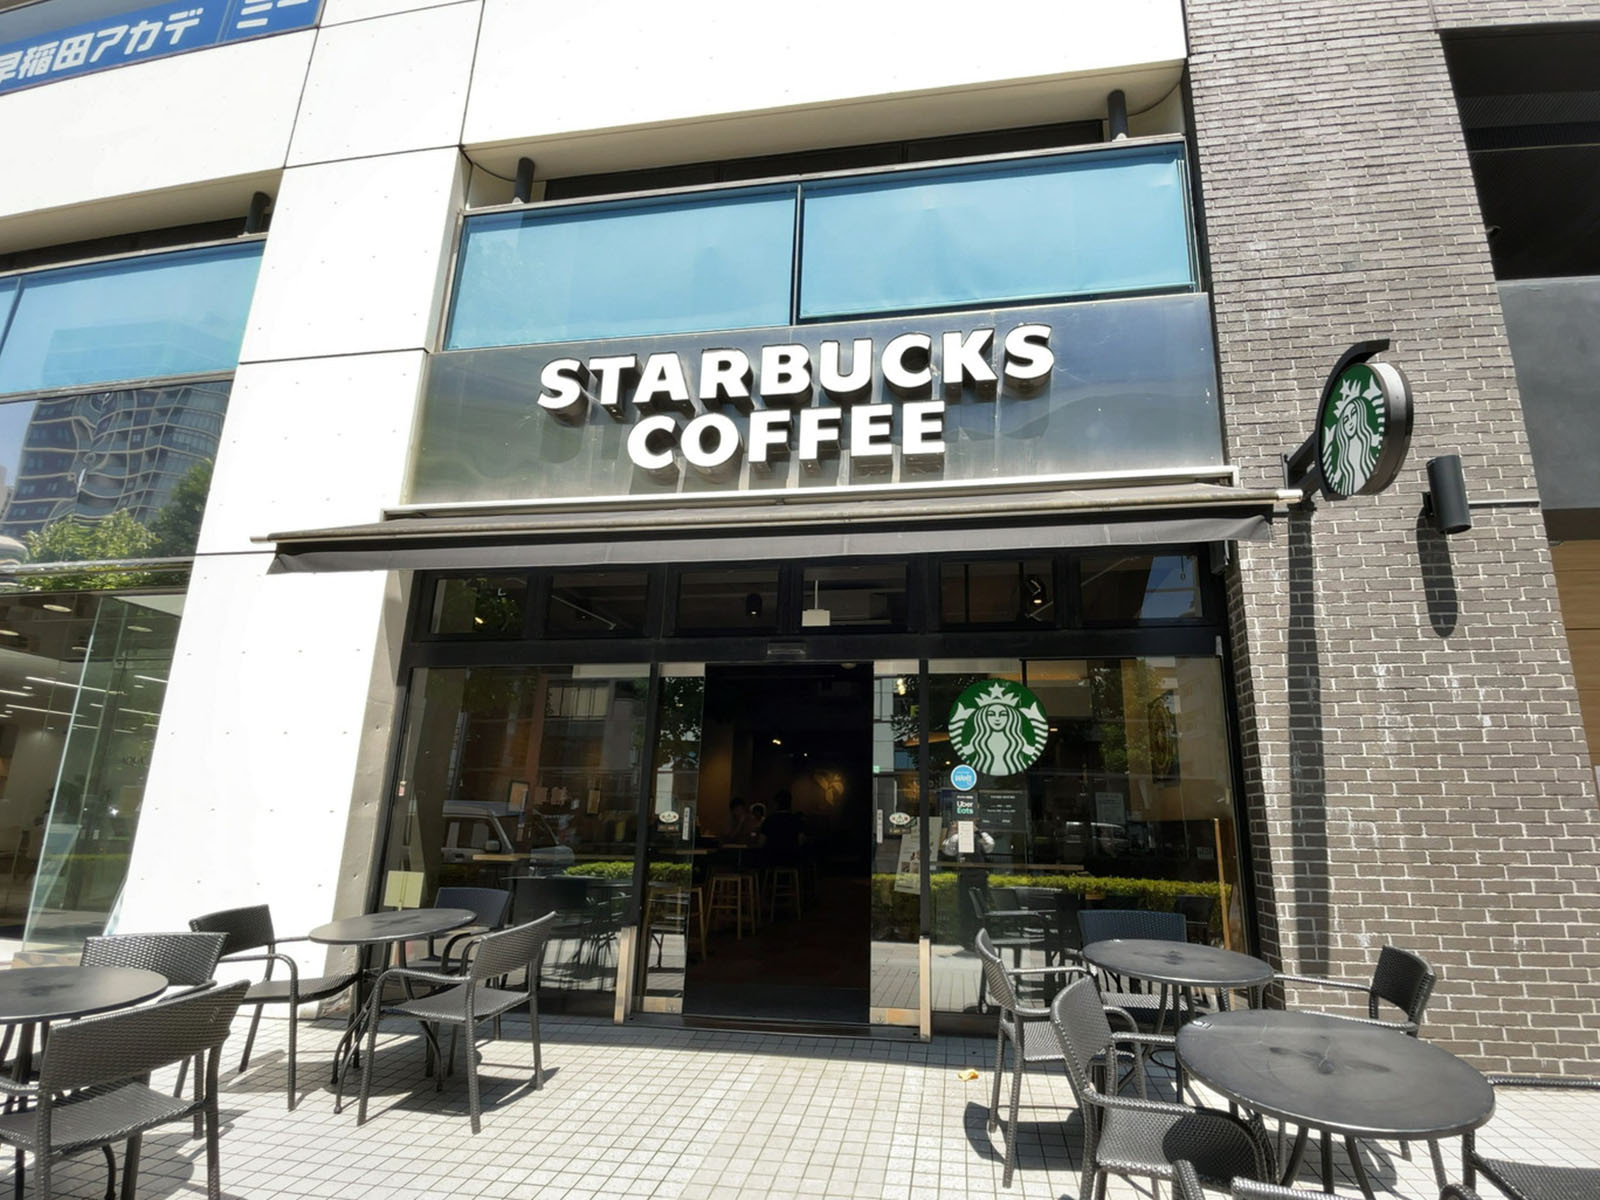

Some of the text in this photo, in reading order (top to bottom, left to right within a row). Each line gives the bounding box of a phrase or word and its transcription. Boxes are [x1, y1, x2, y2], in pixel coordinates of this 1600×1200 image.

[537, 324, 1056, 411] STARBUCKS
[627, 400, 946, 470] COFFEE
[956, 800, 974, 808] Uber
[956, 807, 974, 815] Eats
